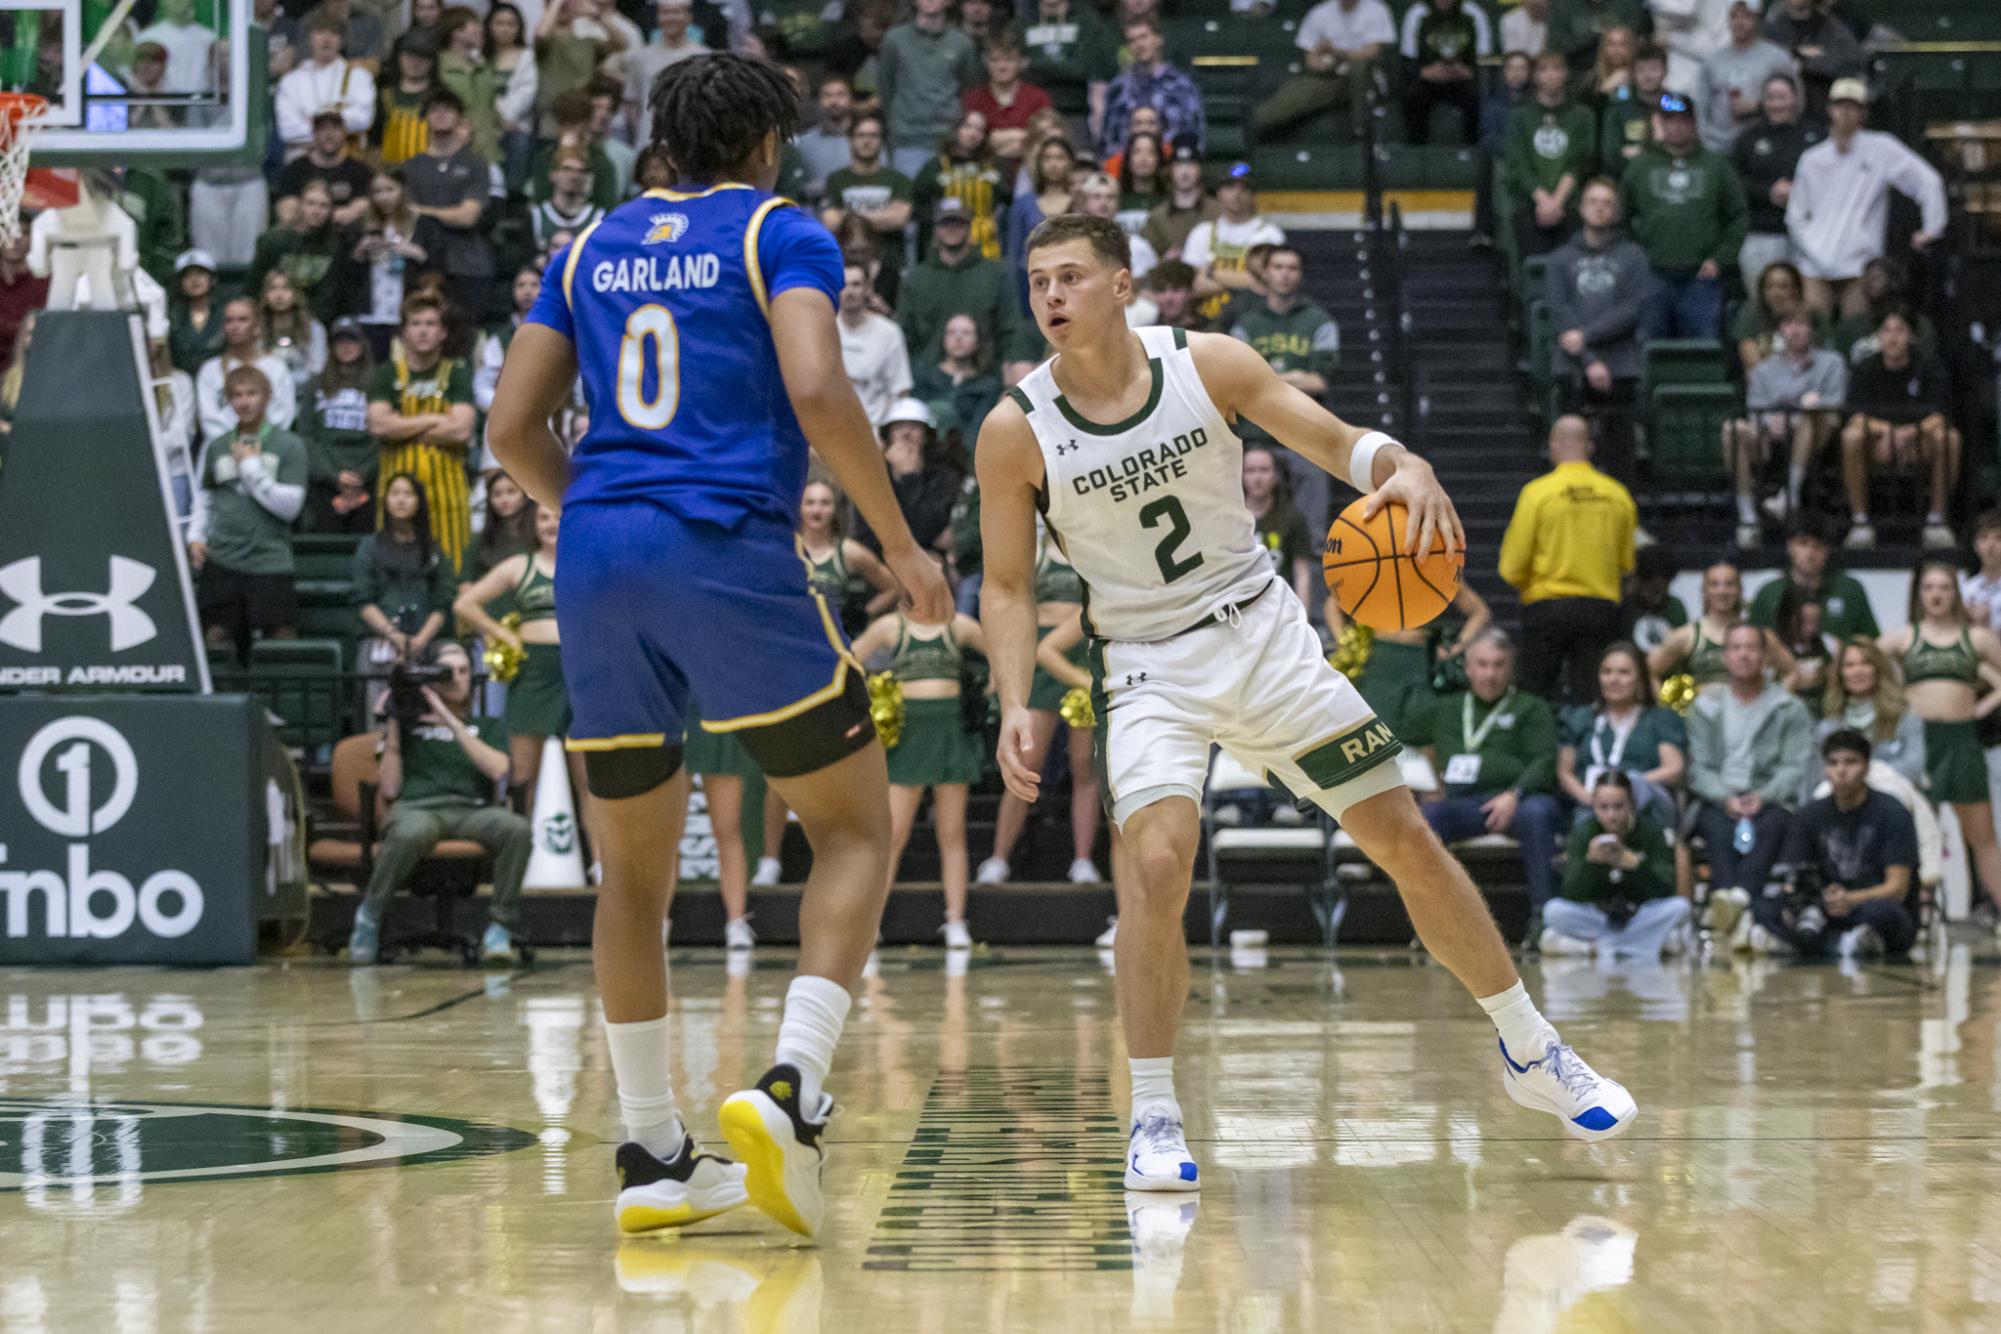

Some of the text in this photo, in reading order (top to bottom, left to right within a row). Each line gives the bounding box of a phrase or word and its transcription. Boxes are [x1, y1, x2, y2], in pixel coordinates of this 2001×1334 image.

[592, 253, 720, 292] GARLAND
[617, 303, 680, 430] 0
[1072, 427, 1208, 495] COLORADO
[1110, 459, 1188, 502] STATE
[1138, 494, 1204, 584] 2
[67, 665, 186, 683] ARMOUR
[902, 1127, 1125, 1165] STATE
[861, 1170, 1137, 1271] COLORADO
